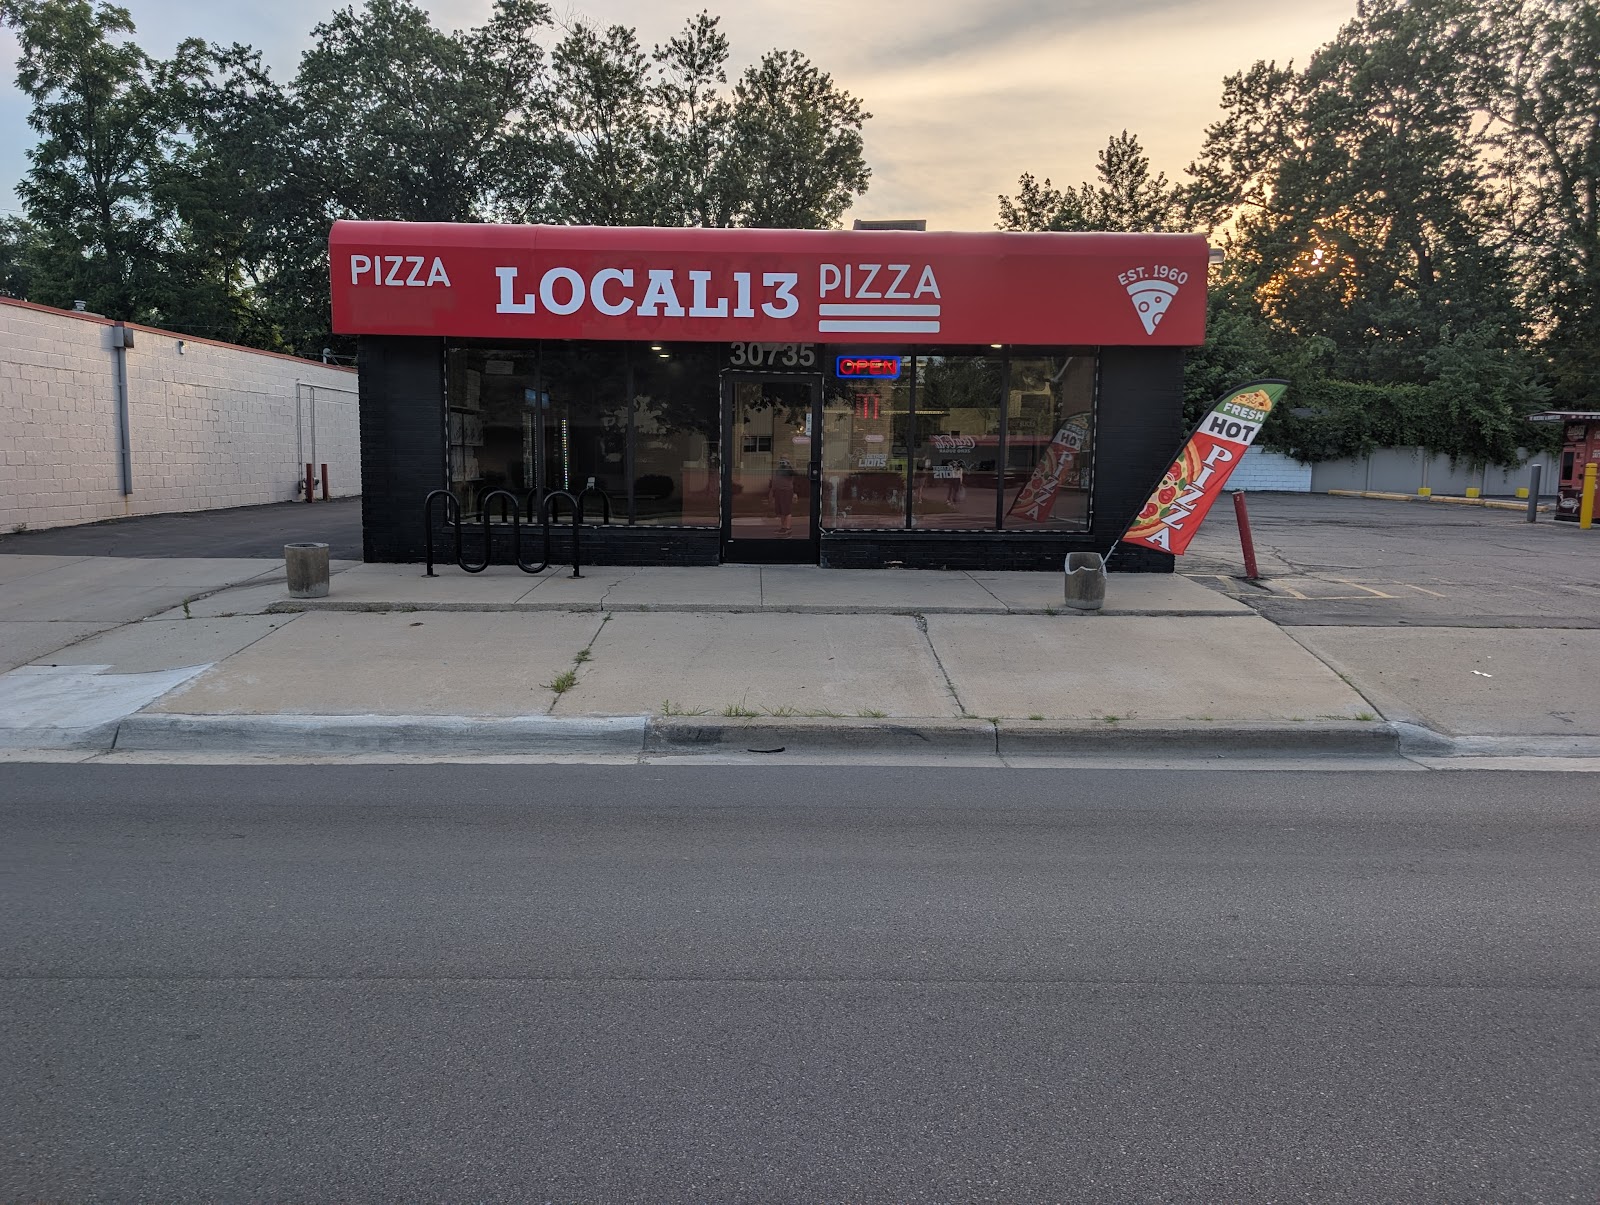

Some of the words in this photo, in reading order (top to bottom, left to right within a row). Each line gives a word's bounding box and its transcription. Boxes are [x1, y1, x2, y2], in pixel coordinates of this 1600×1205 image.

[350, 254, 451, 287] PIZZA
[1117, 266, 1149, 286] EST.
[1152, 264, 1188, 285] 1960
[495, 266, 799, 319] LOCAL13
[818, 263, 941, 299] PIZZA
[729, 342, 815, 367] 30735
[839, 359, 897, 375] OPEN
[1222, 402, 1266, 422] FRESH
[1208, 416, 1255, 442] HOT
[858, 458, 887, 467] LIONS
[1025, 450, 1074, 521] PIZZA
[1145, 443, 1233, 552] PIZZA
